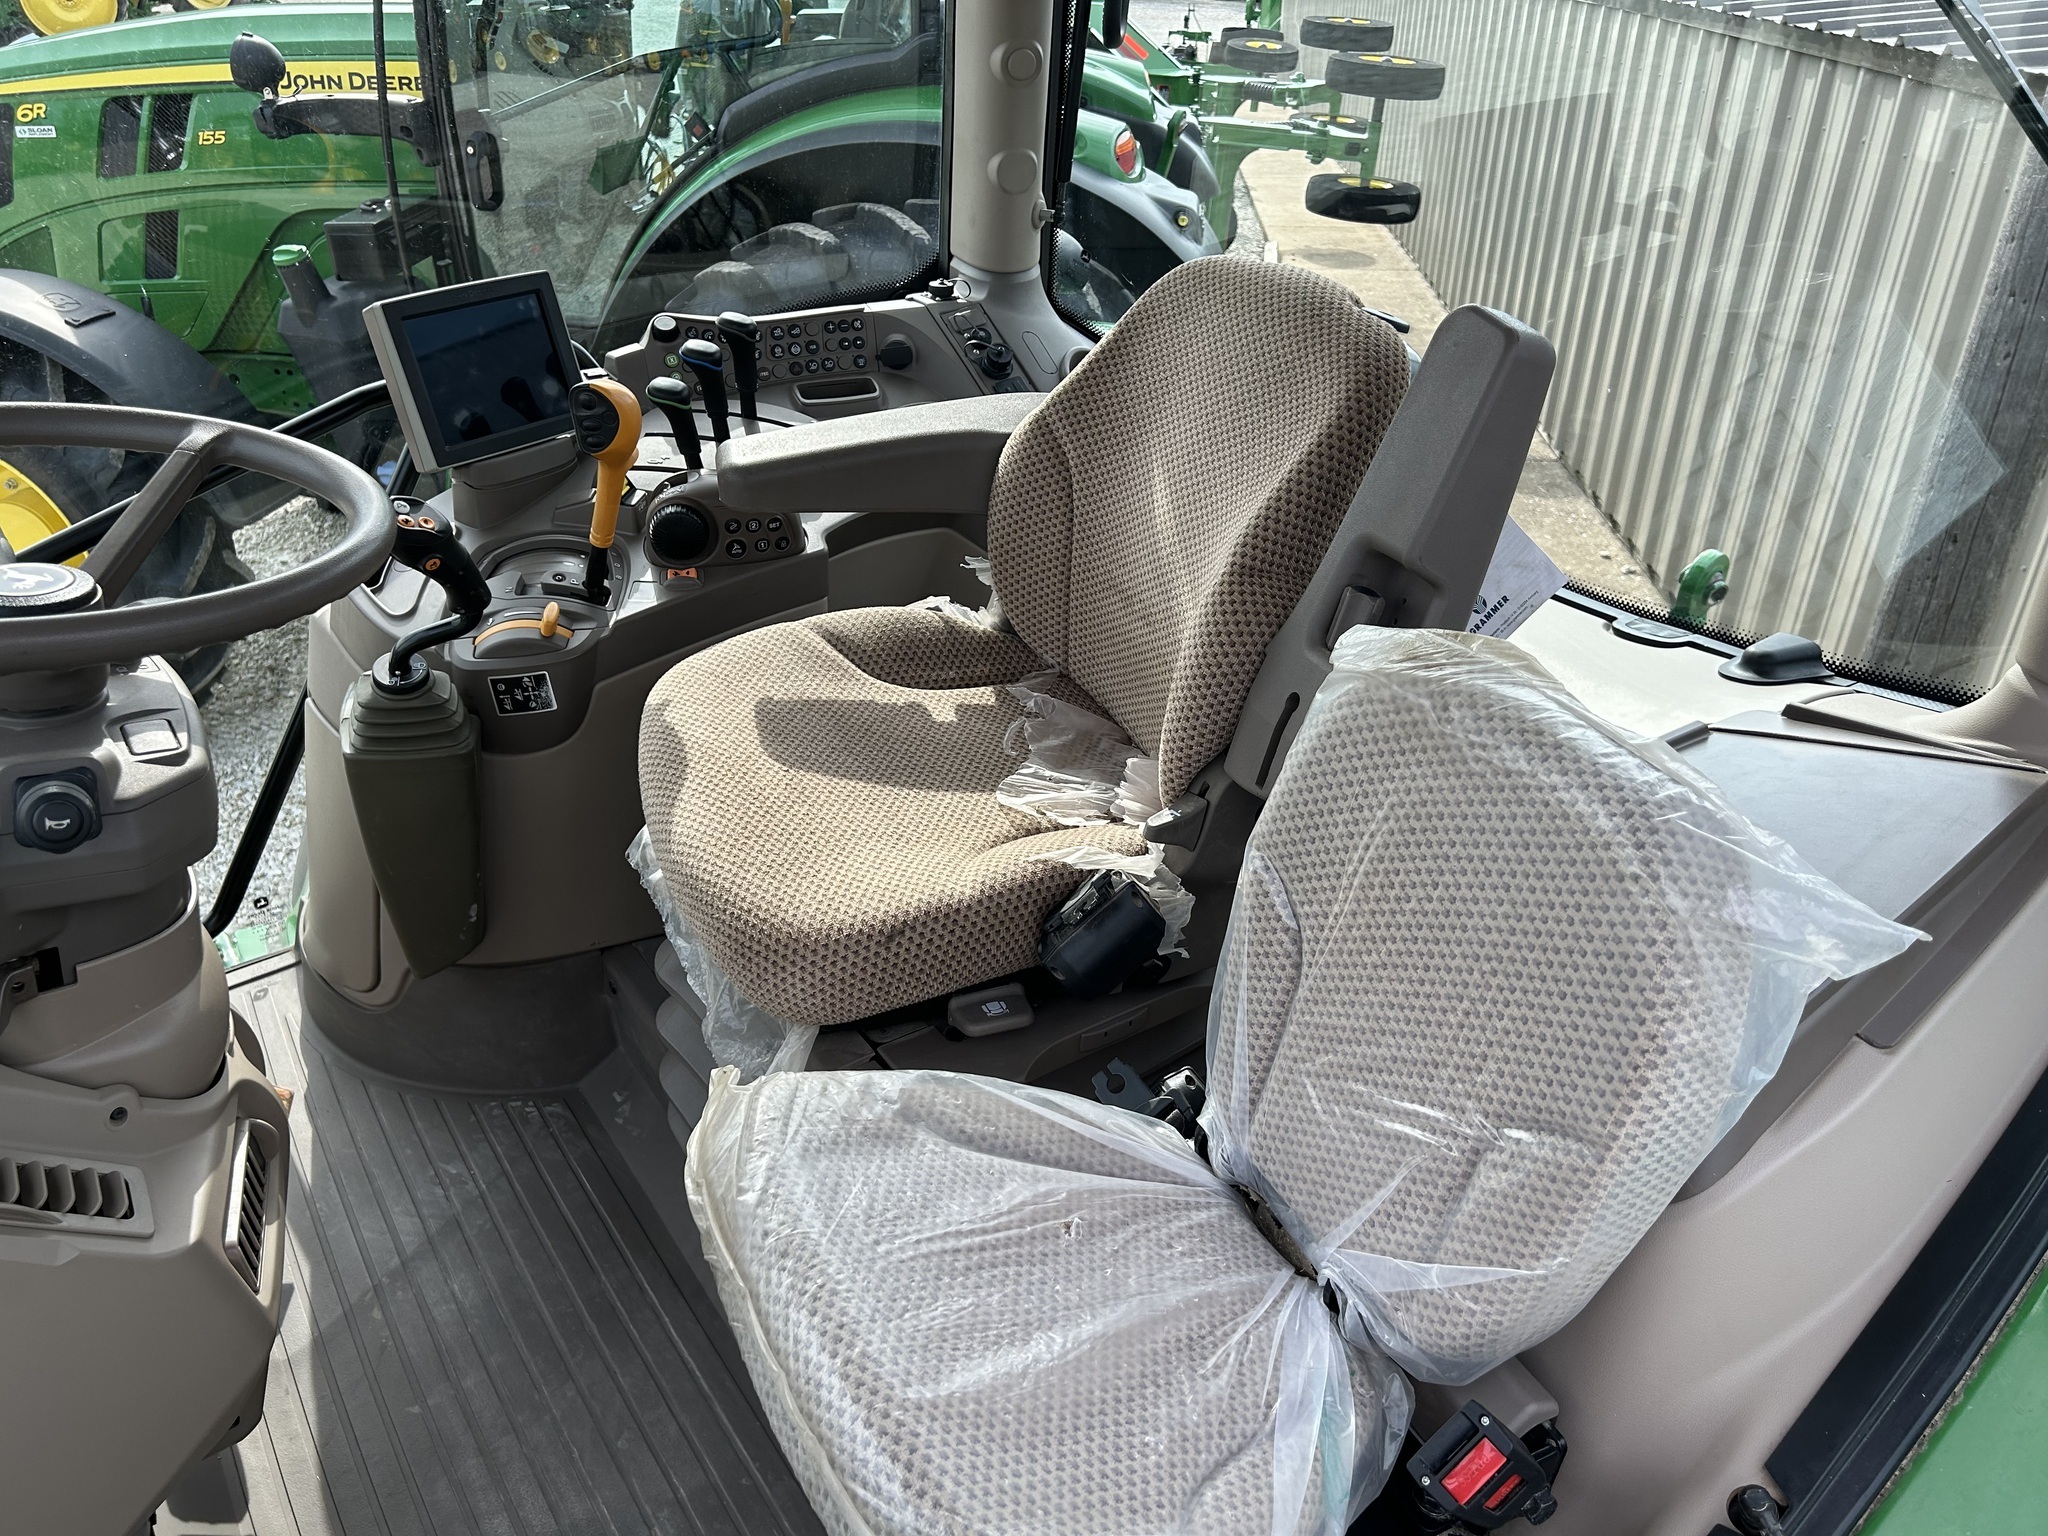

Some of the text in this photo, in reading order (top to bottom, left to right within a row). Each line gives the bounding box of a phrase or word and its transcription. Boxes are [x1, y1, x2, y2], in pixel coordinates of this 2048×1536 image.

[280, 71, 343, 91] JOHN
[16, 103, 47, 123] 6R
[198, 130, 226, 145] 155
[1470, 595, 1510, 634] GRAMMER
